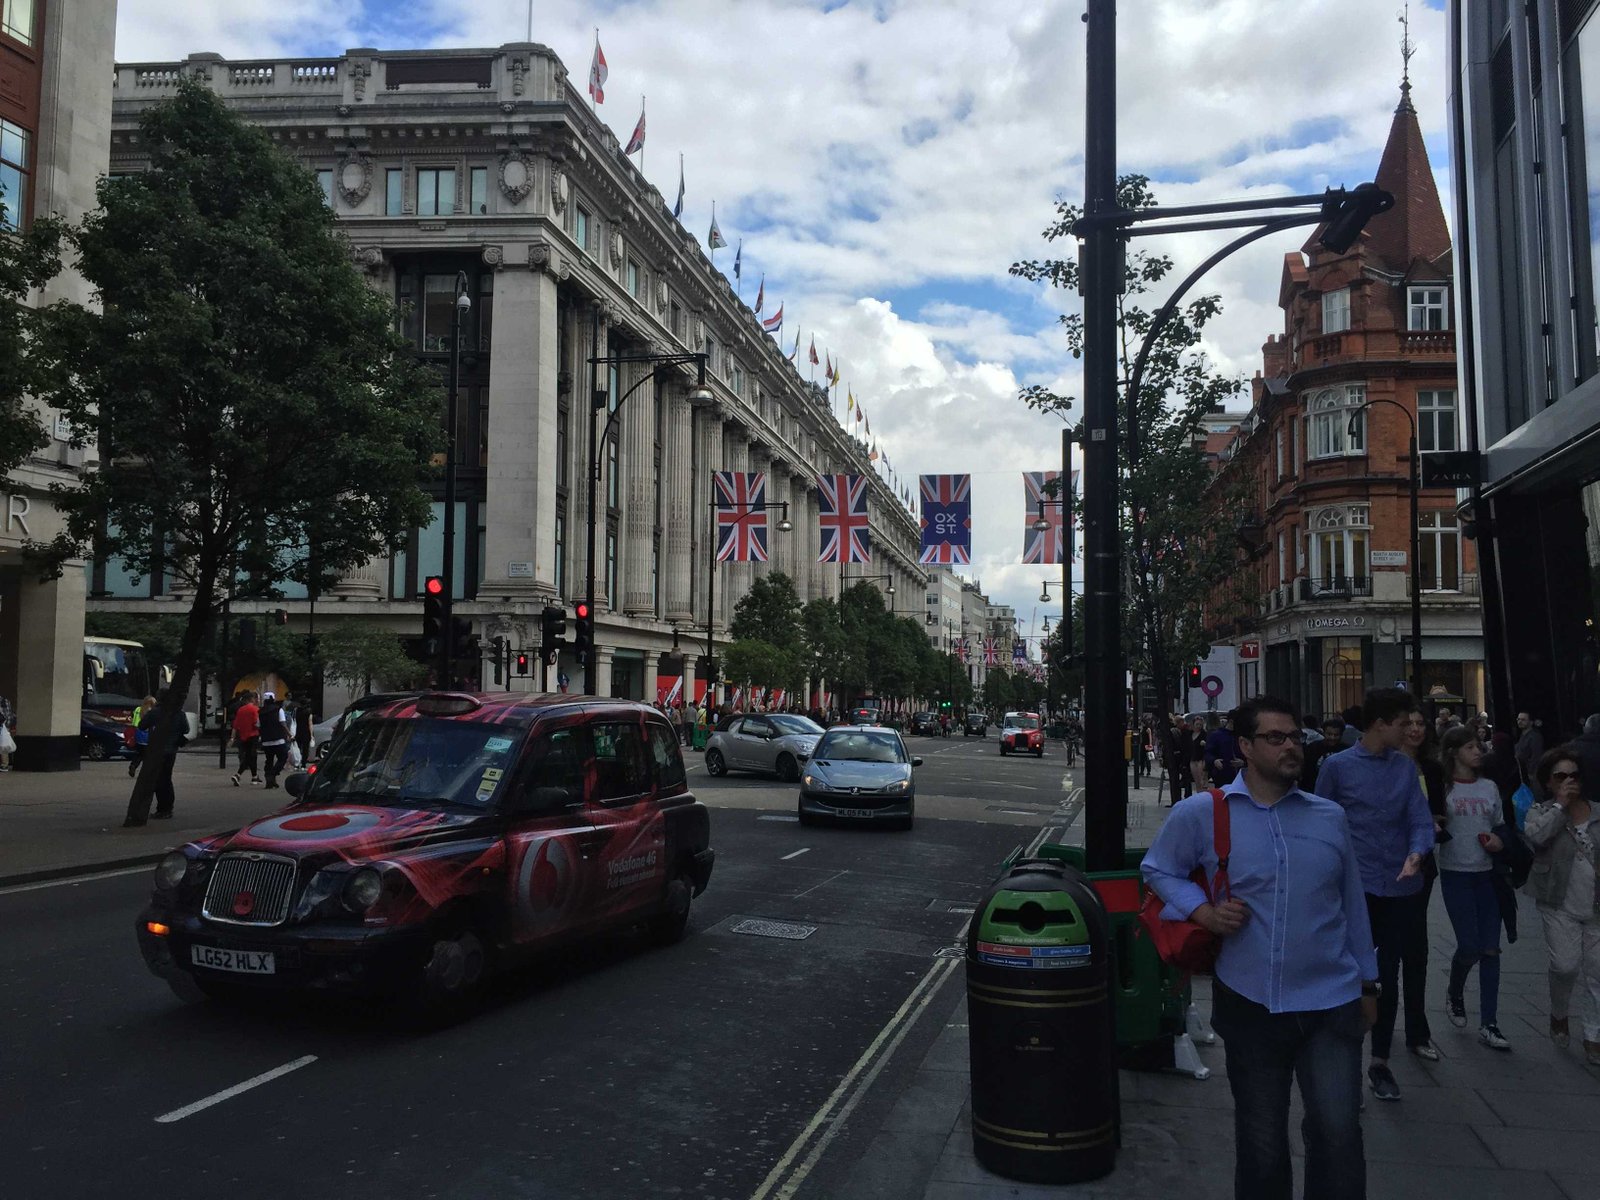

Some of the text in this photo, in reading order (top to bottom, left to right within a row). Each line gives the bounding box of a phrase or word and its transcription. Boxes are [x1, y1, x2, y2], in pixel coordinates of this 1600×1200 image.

[1431, 473, 1471, 481] ZARA
[934, 512, 957, 523] OX
[935, 524, 957, 534] ST.
[1315, 618, 1349, 629] OMEGA
[608, 850, 656, 875] Vodafone 4G
[196, 946, 270, 971] LG52 HLX
